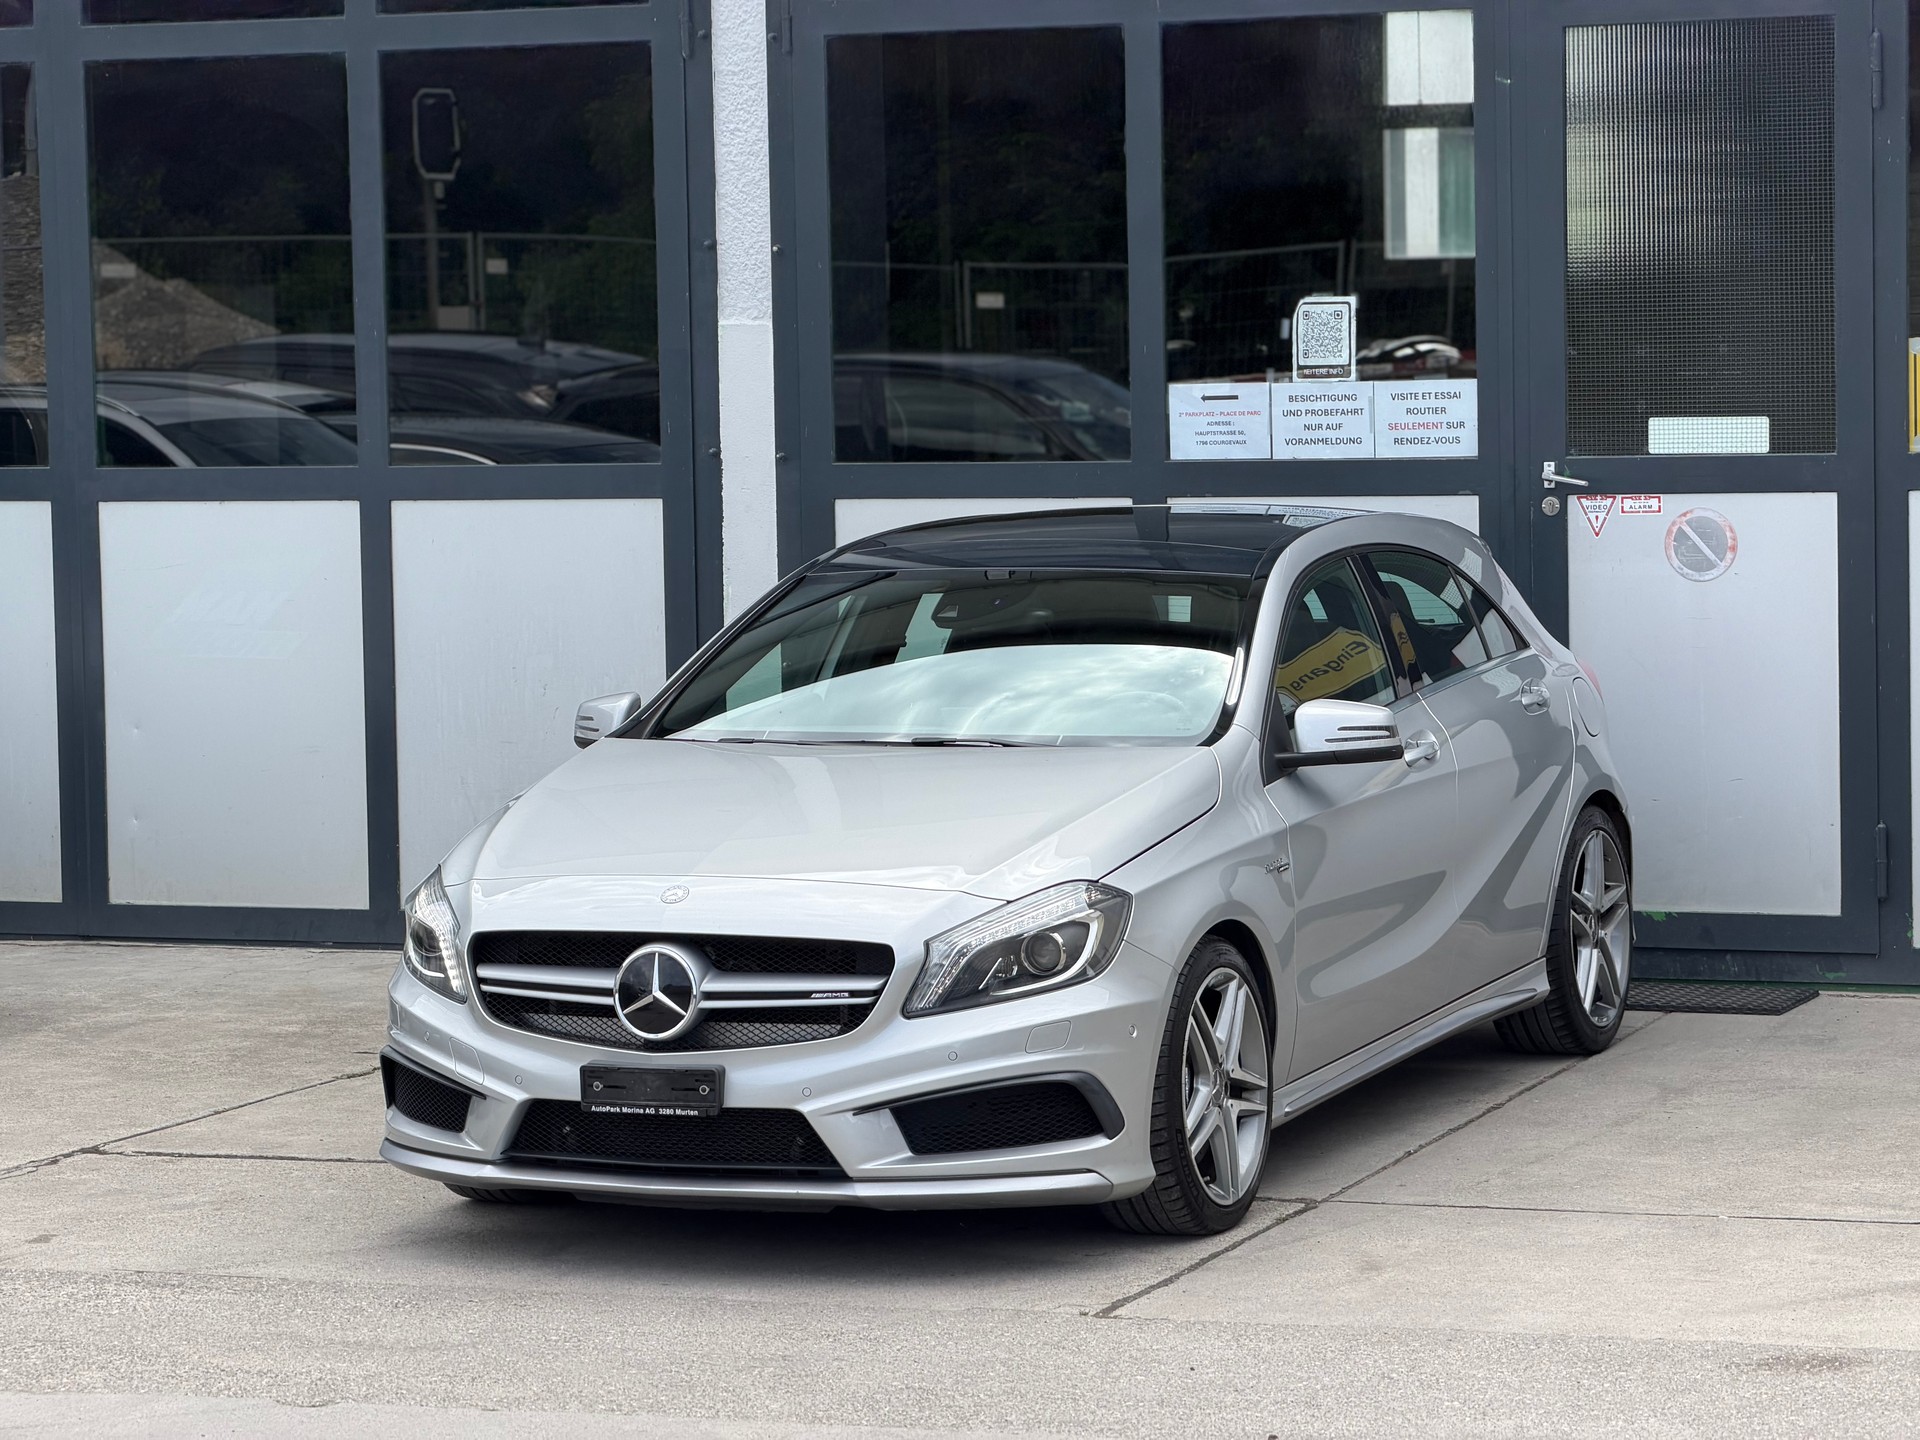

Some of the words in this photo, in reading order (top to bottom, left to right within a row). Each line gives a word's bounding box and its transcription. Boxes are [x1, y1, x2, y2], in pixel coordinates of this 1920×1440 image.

[1288, 394, 1358, 403] BESICHTIGUNG
[1390, 392, 1420, 401] VISITE
[1421, 392, 1433, 400] ET
[1434, 391, 1462, 400] ESSAI
[1282, 409, 1303, 417] UND
[1304, 408, 1364, 417] PROBEFAHRT
[1406, 406, 1447, 416] ROUTIER
[1303, 423, 1324, 431] NUR
[1325, 423, 1344, 431] AUF
[1387, 421, 1444, 431] SEULEMENT
[1445, 421, 1466, 429] SUR
[1284, 437, 1363, 446] VORANMELDUNG
[1393, 436, 1461, 446] RENDEZ-VOUS
[591, 1105, 621, 1113] AutoPark
[622, 1106, 644, 1114] Morina
[675, 1108, 698, 1116] Murten
